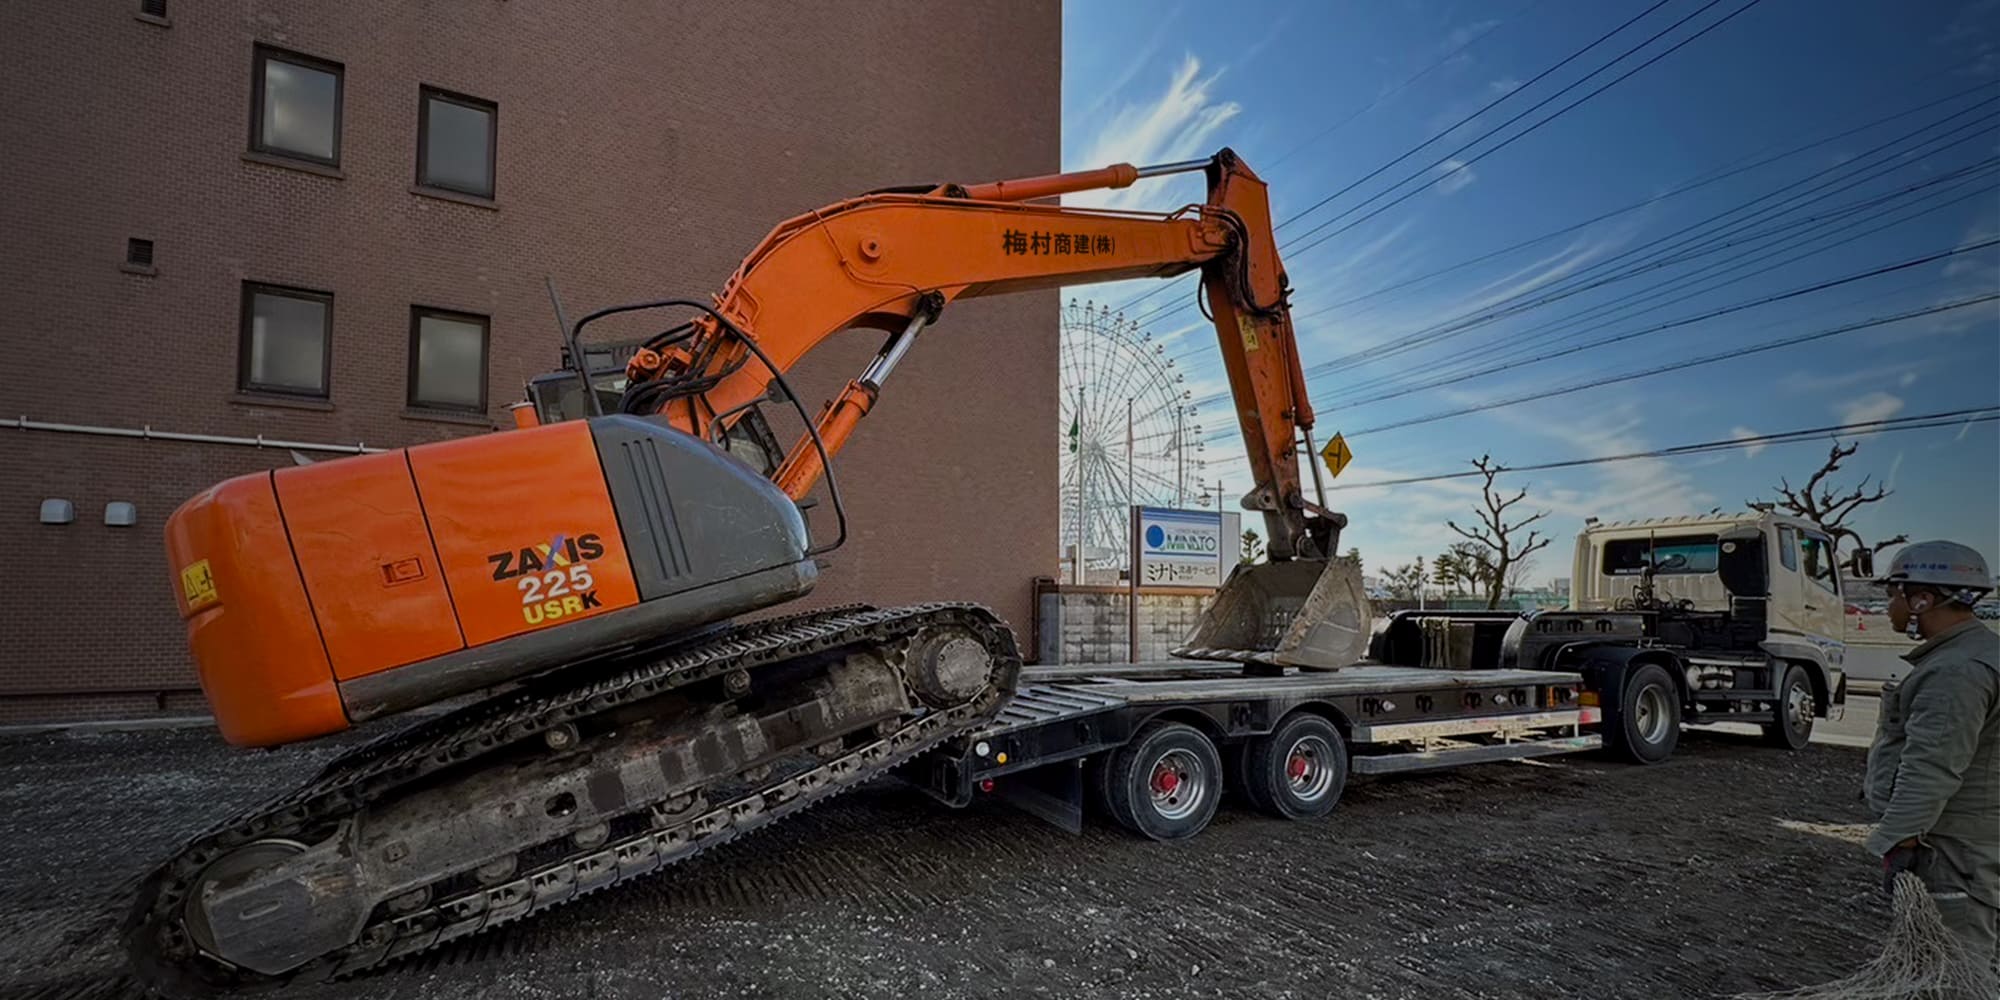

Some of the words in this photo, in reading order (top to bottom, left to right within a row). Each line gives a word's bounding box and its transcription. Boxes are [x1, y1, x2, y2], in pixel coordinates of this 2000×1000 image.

[488, 533, 604, 581] ZAXIS
[1167, 534, 1216, 551] MINATO
[518, 564, 593, 604] 225
[523, 591, 601, 624] USRK
